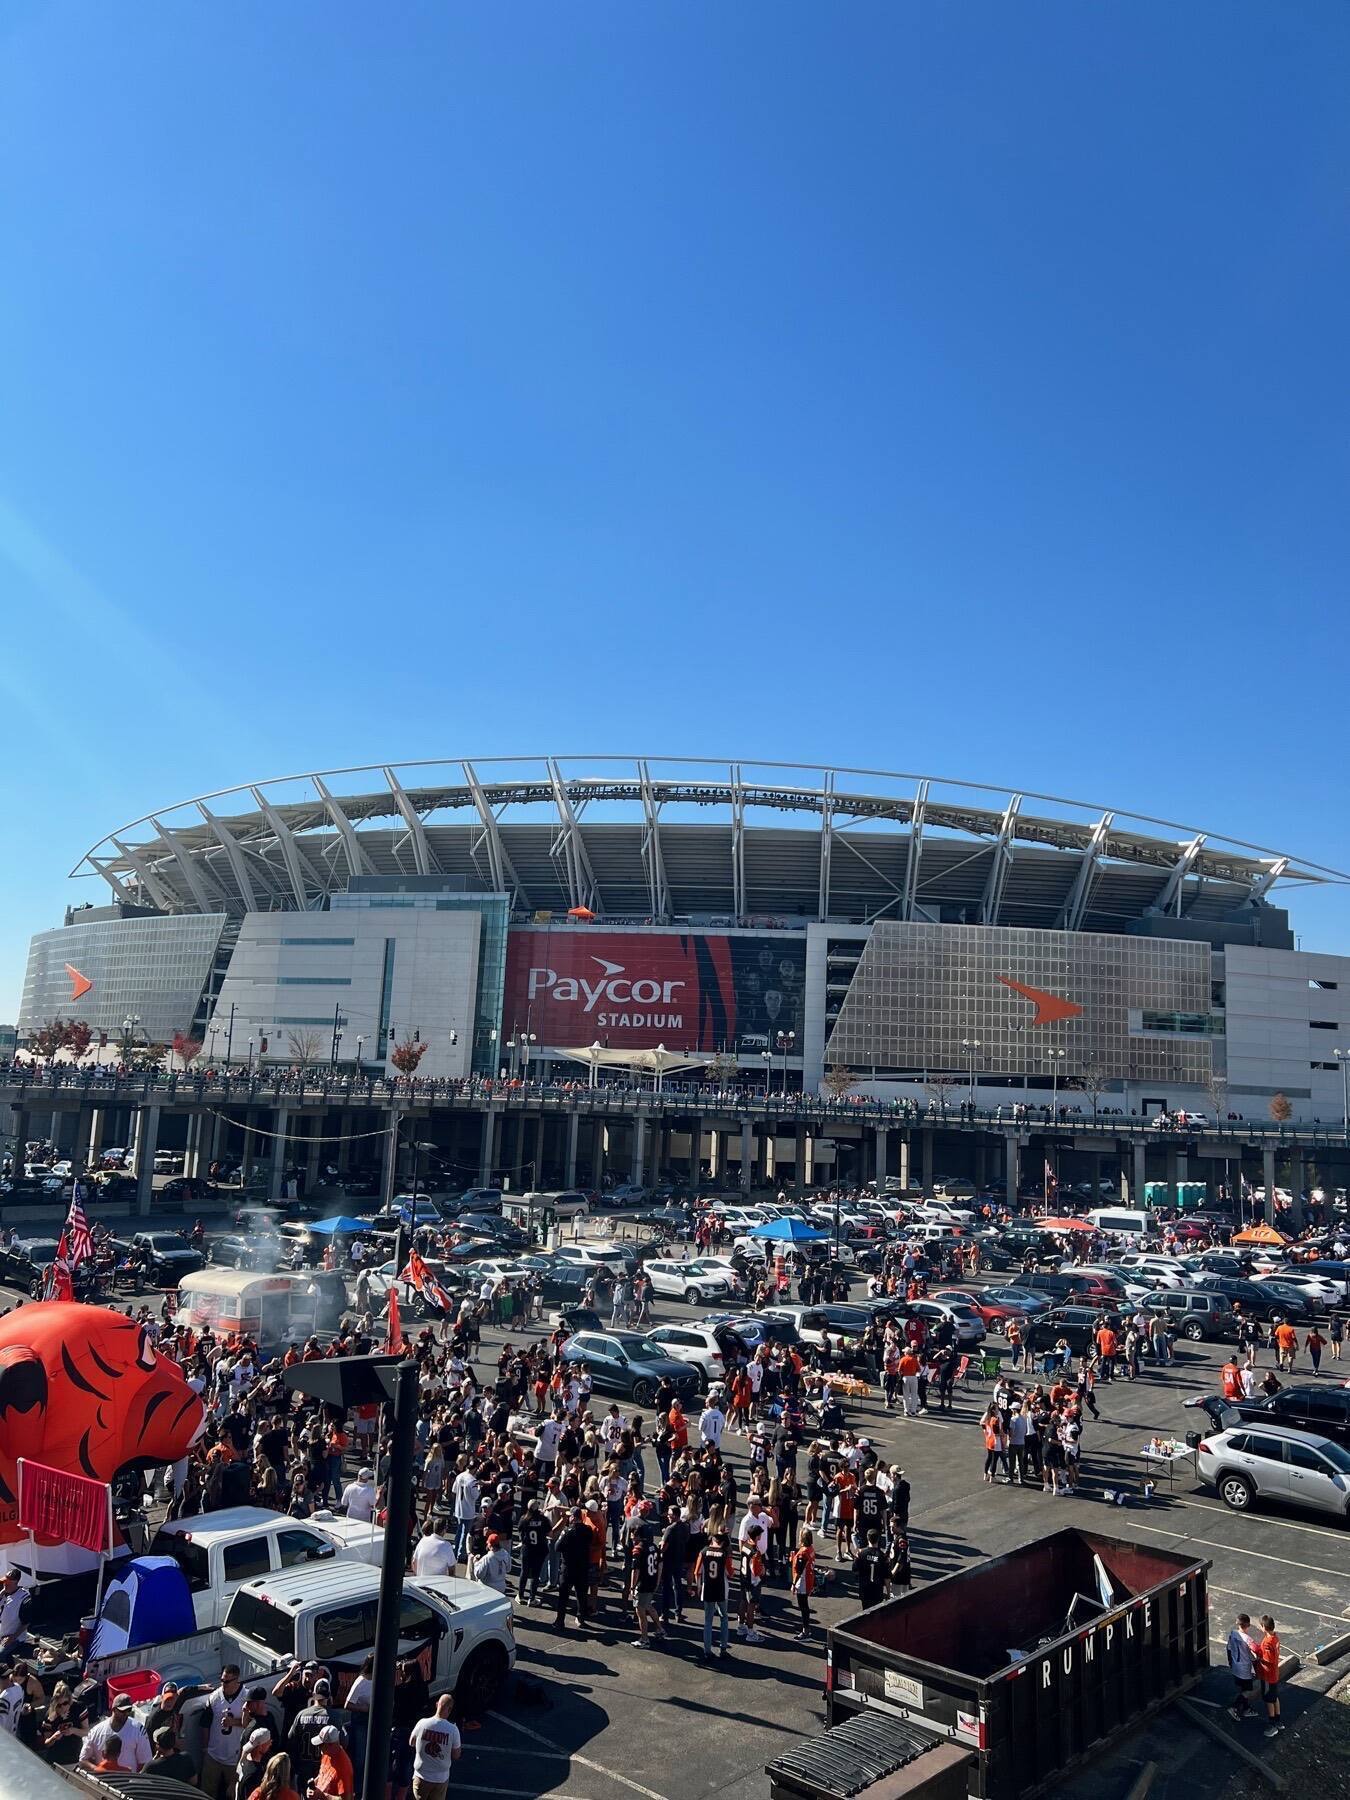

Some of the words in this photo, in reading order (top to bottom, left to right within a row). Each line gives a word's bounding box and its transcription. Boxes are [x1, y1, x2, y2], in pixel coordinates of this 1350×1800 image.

[527, 968, 685, 1012] Paycor
[597, 1012, 683, 1028] STADIUM
[997, 1397, 1008, 1410] 98
[609, 1426, 622, 1440] 28
[863, 1499, 878, 1515] 85
[529, 1531, 538, 1545] 9
[709, 1560, 718, 1579] 9
[870, 1563, 875, 1582] 1
[1042, 1601, 1152, 1689] RUMPKE
